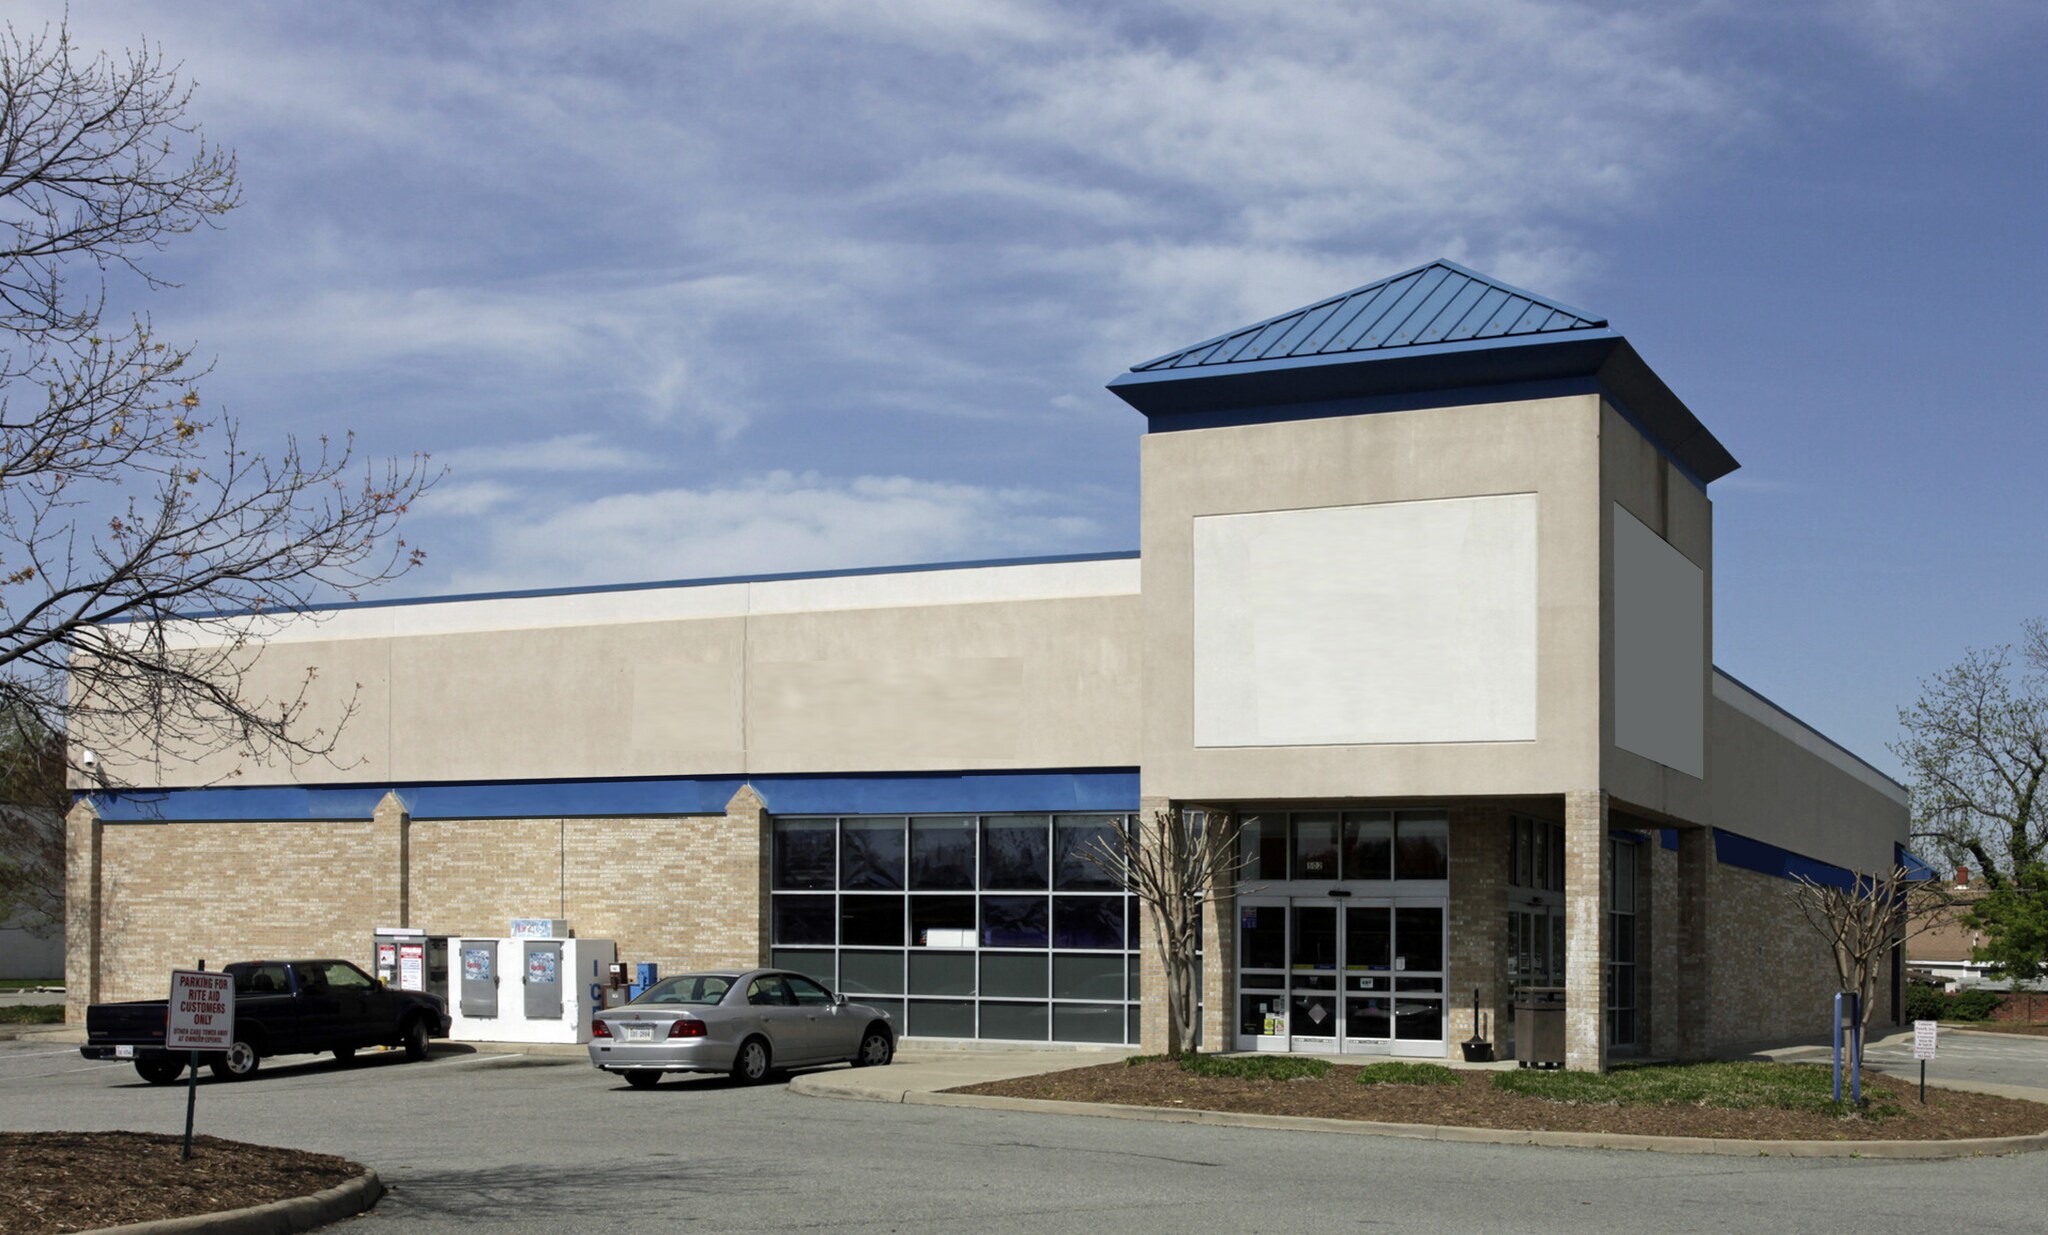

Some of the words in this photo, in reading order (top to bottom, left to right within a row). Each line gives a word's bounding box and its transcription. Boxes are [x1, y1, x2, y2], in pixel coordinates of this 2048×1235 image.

[180, 976, 213, 989] PARKING
[214, 978, 228, 990] FOR
[188, 989, 206, 1001] RITE
[207, 990, 220, 1002] AID
[180, 1001, 226, 1014] CUSTOMERS
[194, 1014, 213, 1025] ONLY
